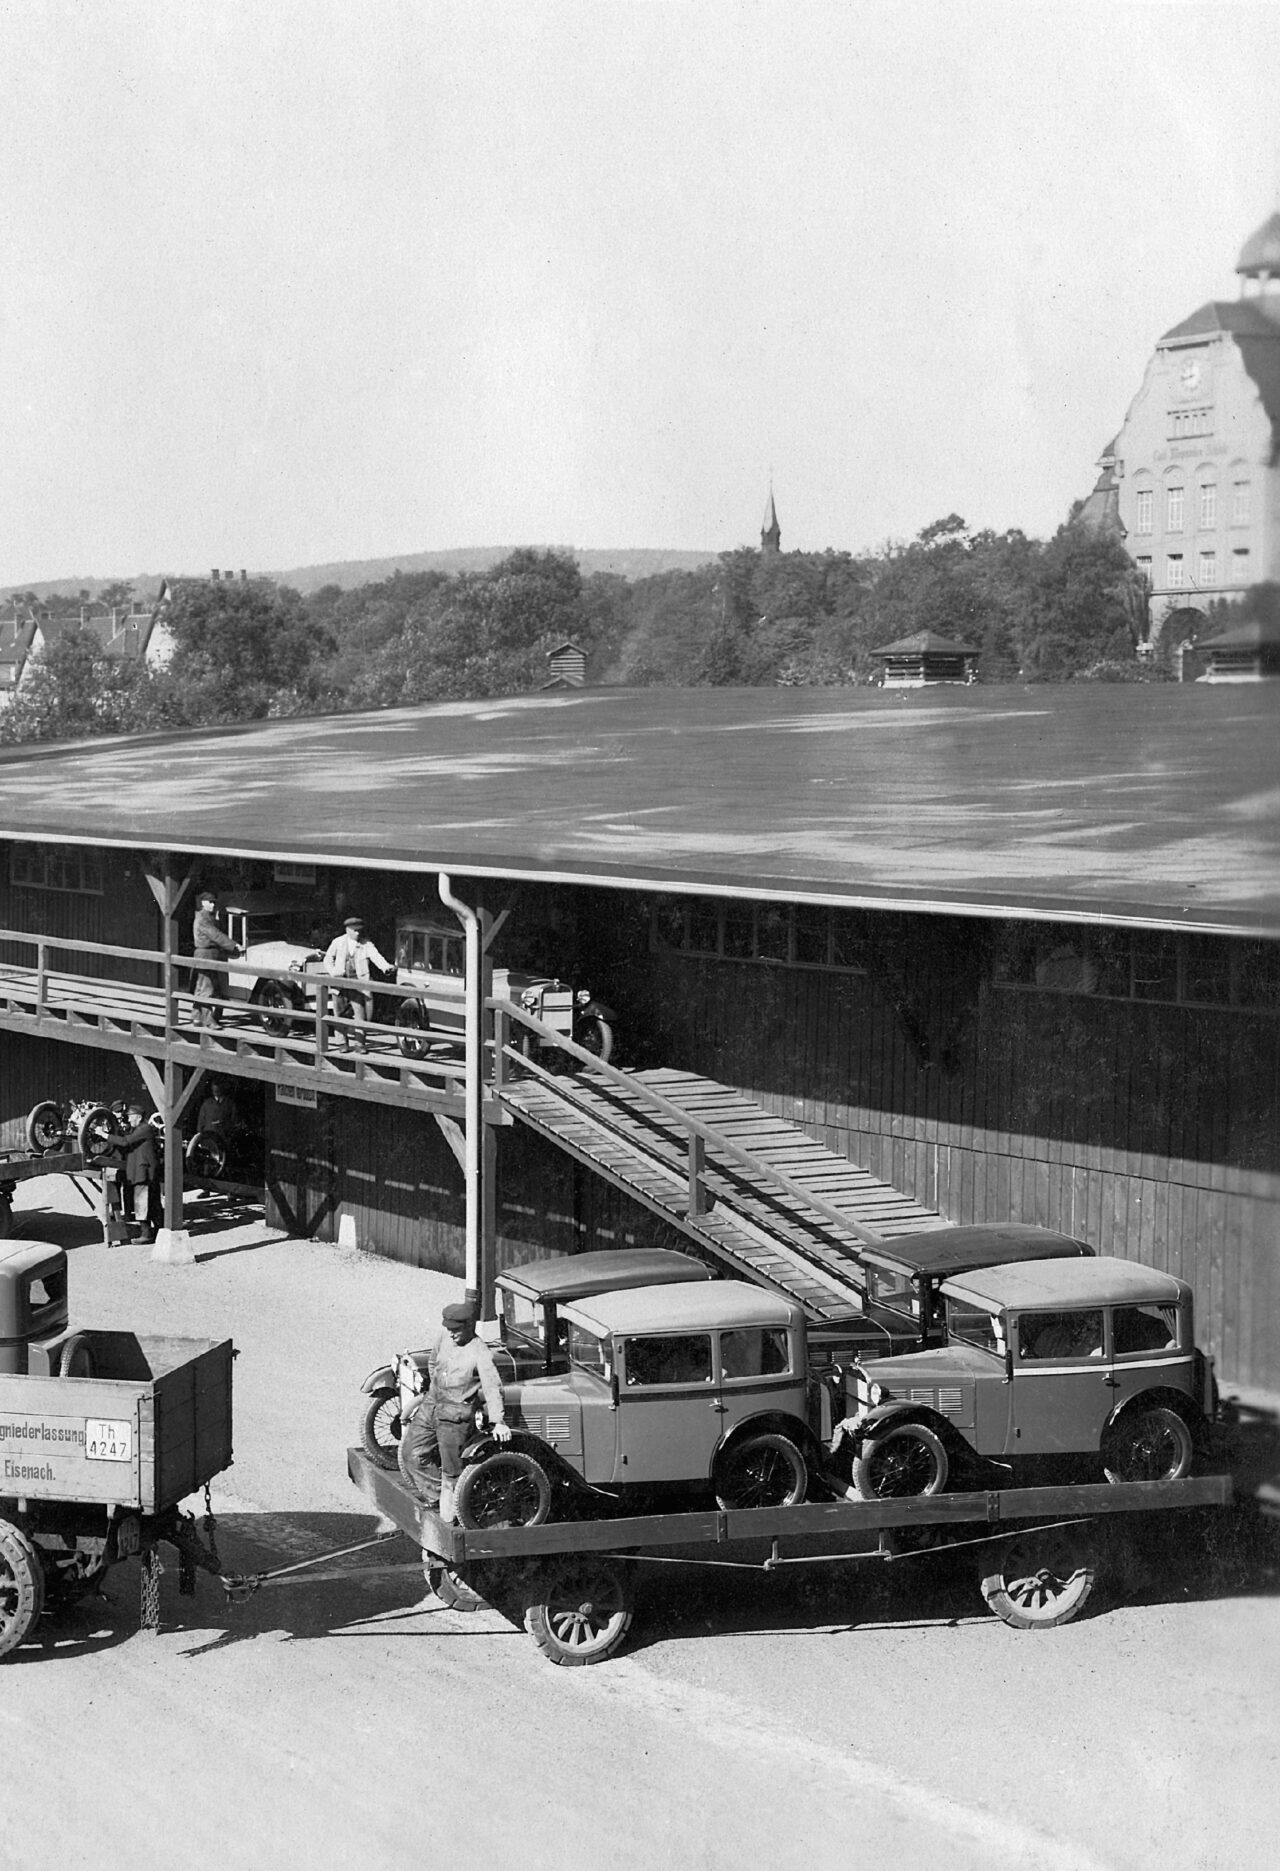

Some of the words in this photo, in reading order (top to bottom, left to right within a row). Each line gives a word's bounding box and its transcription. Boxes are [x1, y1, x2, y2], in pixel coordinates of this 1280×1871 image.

[98, 1424, 115, 1439] Th
[89, 1441, 127, 1457] 4247
[5, 1460, 57, 1481] Eisenach.
